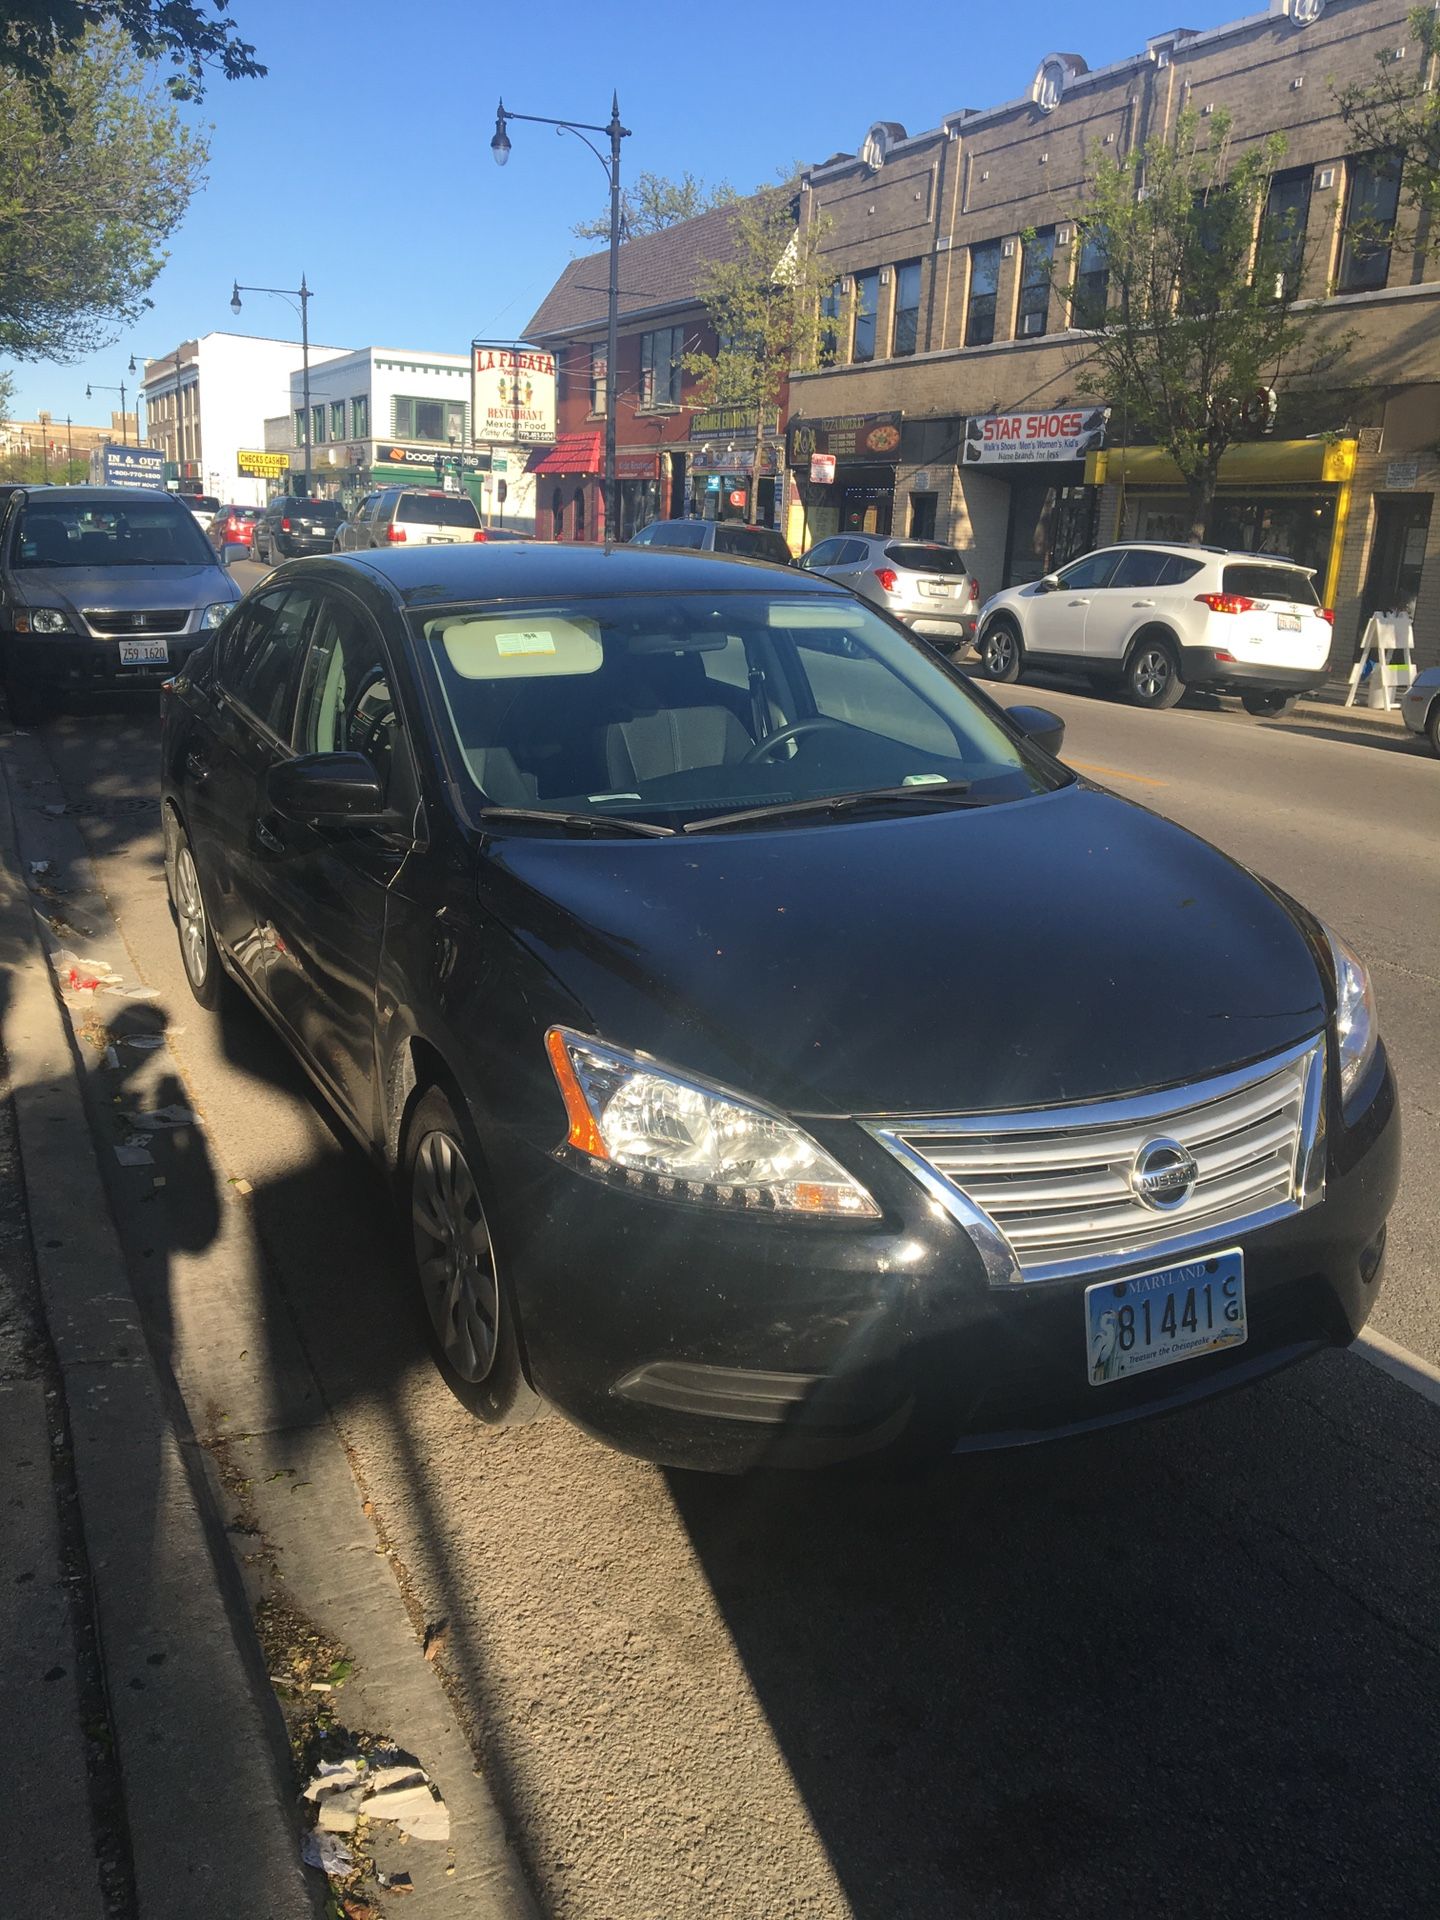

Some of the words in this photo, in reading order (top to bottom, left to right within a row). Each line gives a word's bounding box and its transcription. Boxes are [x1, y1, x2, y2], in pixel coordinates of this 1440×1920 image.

[477, 351, 495, 372] LA
[499, 352, 554, 376] FOGATA
[487, 408, 543, 421] RESTAURANT
[486, 420, 522, 429] Mexican
[524, 422, 546, 430] Food
[983, 417, 1022, 440] STAR
[1026, 412, 1083, 438] SHOES
[108, 454, 120, 463] IN
[125, 455, 134, 464] &
[139, 456, 161, 467] OUT
[241, 454, 263, 464] CHECKS
[264, 456, 288, 466] CASHED
[405, 450, 439, 463] boost
[1014, 451, 1035, 459] Brands
[144, 647, 165, 660] 1620
[1142, 1165, 1197, 1189] NISSAN
[1128, 1263, 1206, 1294] MARYLAND
[1118, 1283, 1213, 1351] 81441
[1129, 1350, 1157, 1363] Treasure
[1159, 1346, 1170, 1355] the
[1171, 1337, 1210, 1351] Chesapeake
